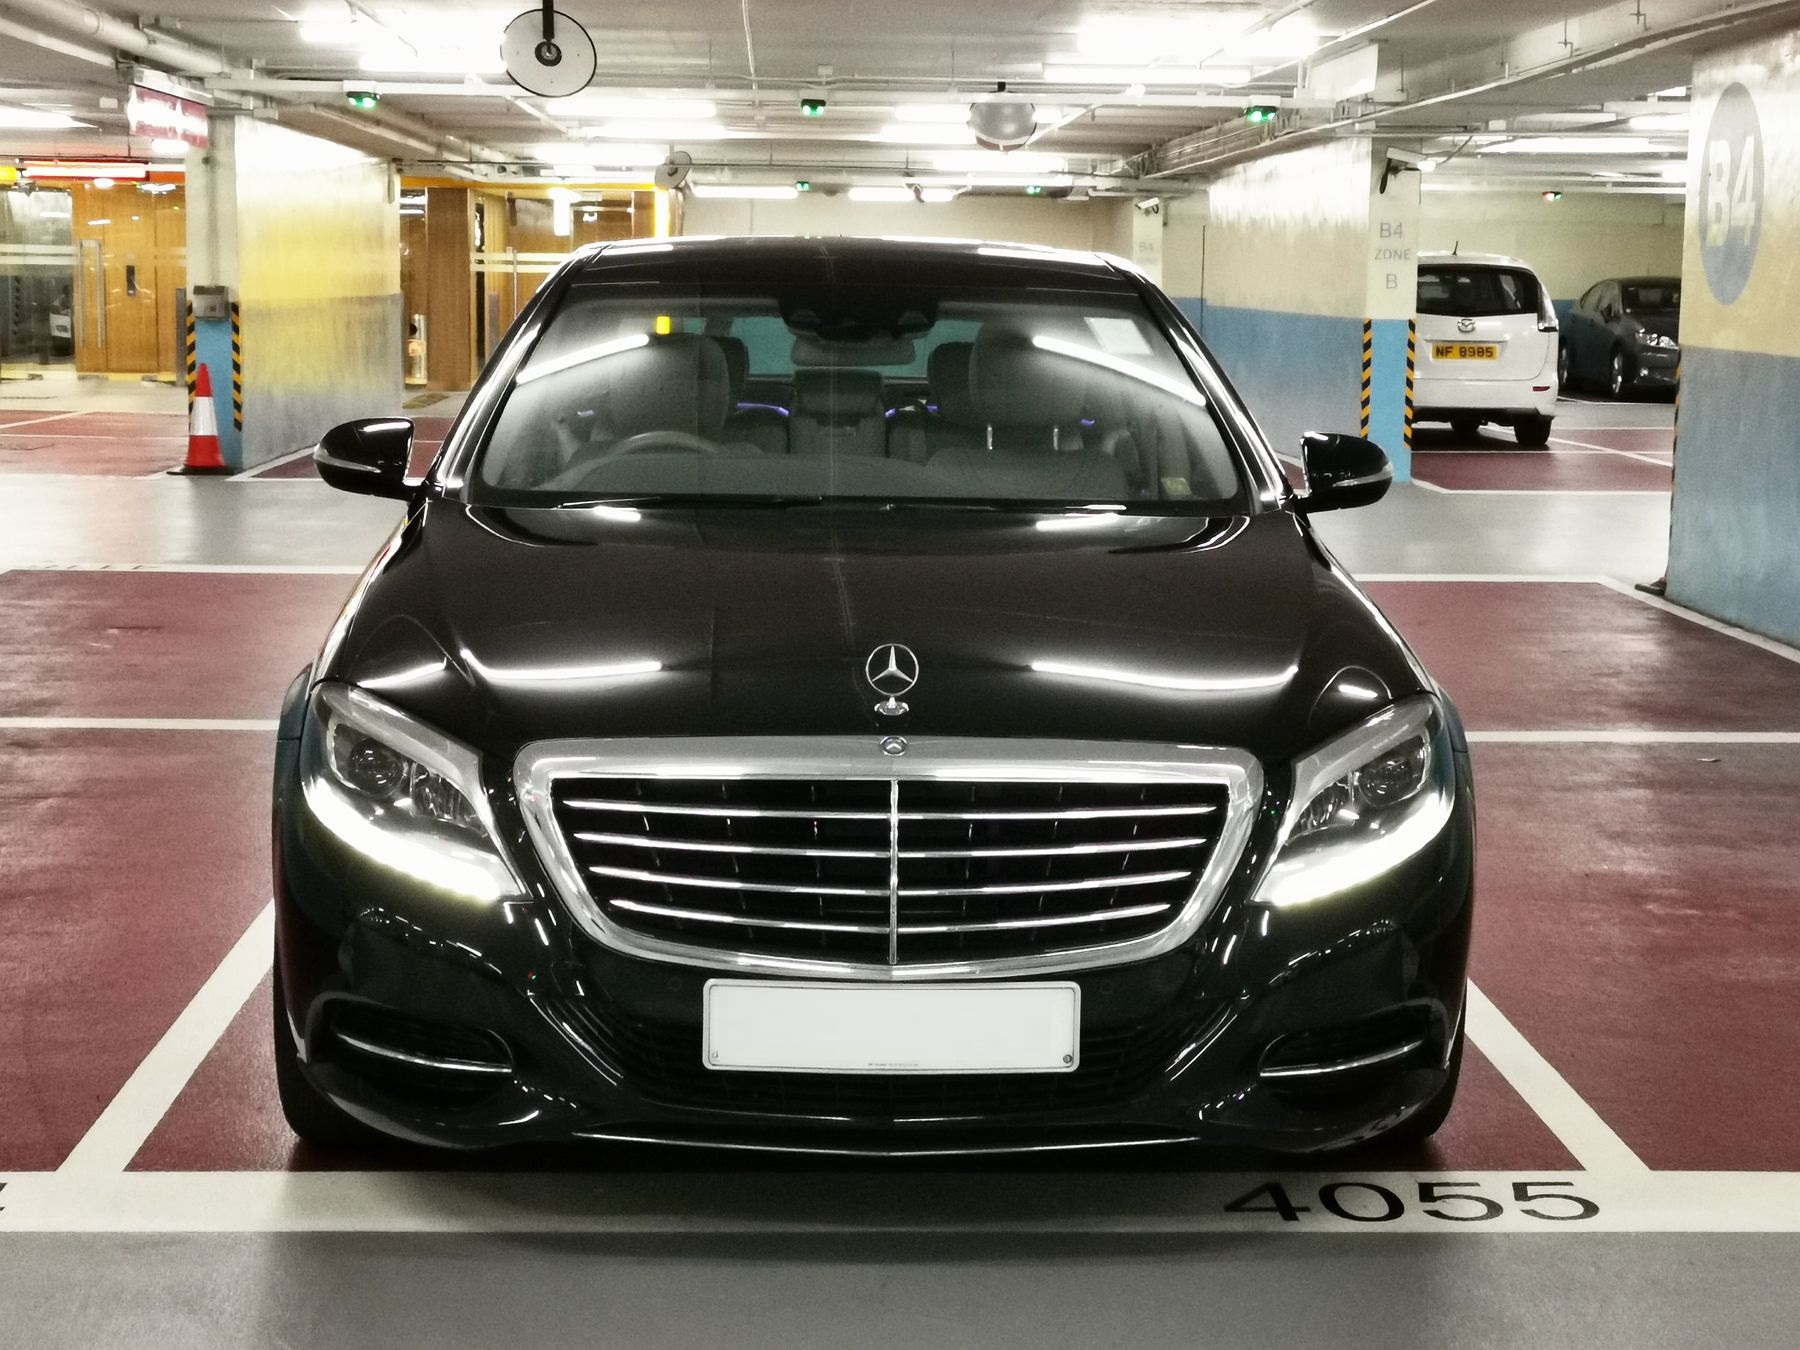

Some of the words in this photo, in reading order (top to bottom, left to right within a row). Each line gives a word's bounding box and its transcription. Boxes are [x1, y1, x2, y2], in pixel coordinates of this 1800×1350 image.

[1706, 136, 1756, 247] B4
[1380, 222, 1403, 239] B4
[1374, 248, 1411, 261] ZONE
[1386, 273, 1398, 289] B
[1435, 346, 1454, 357] NF
[1223, 1181, 1600, 1222] 4055
